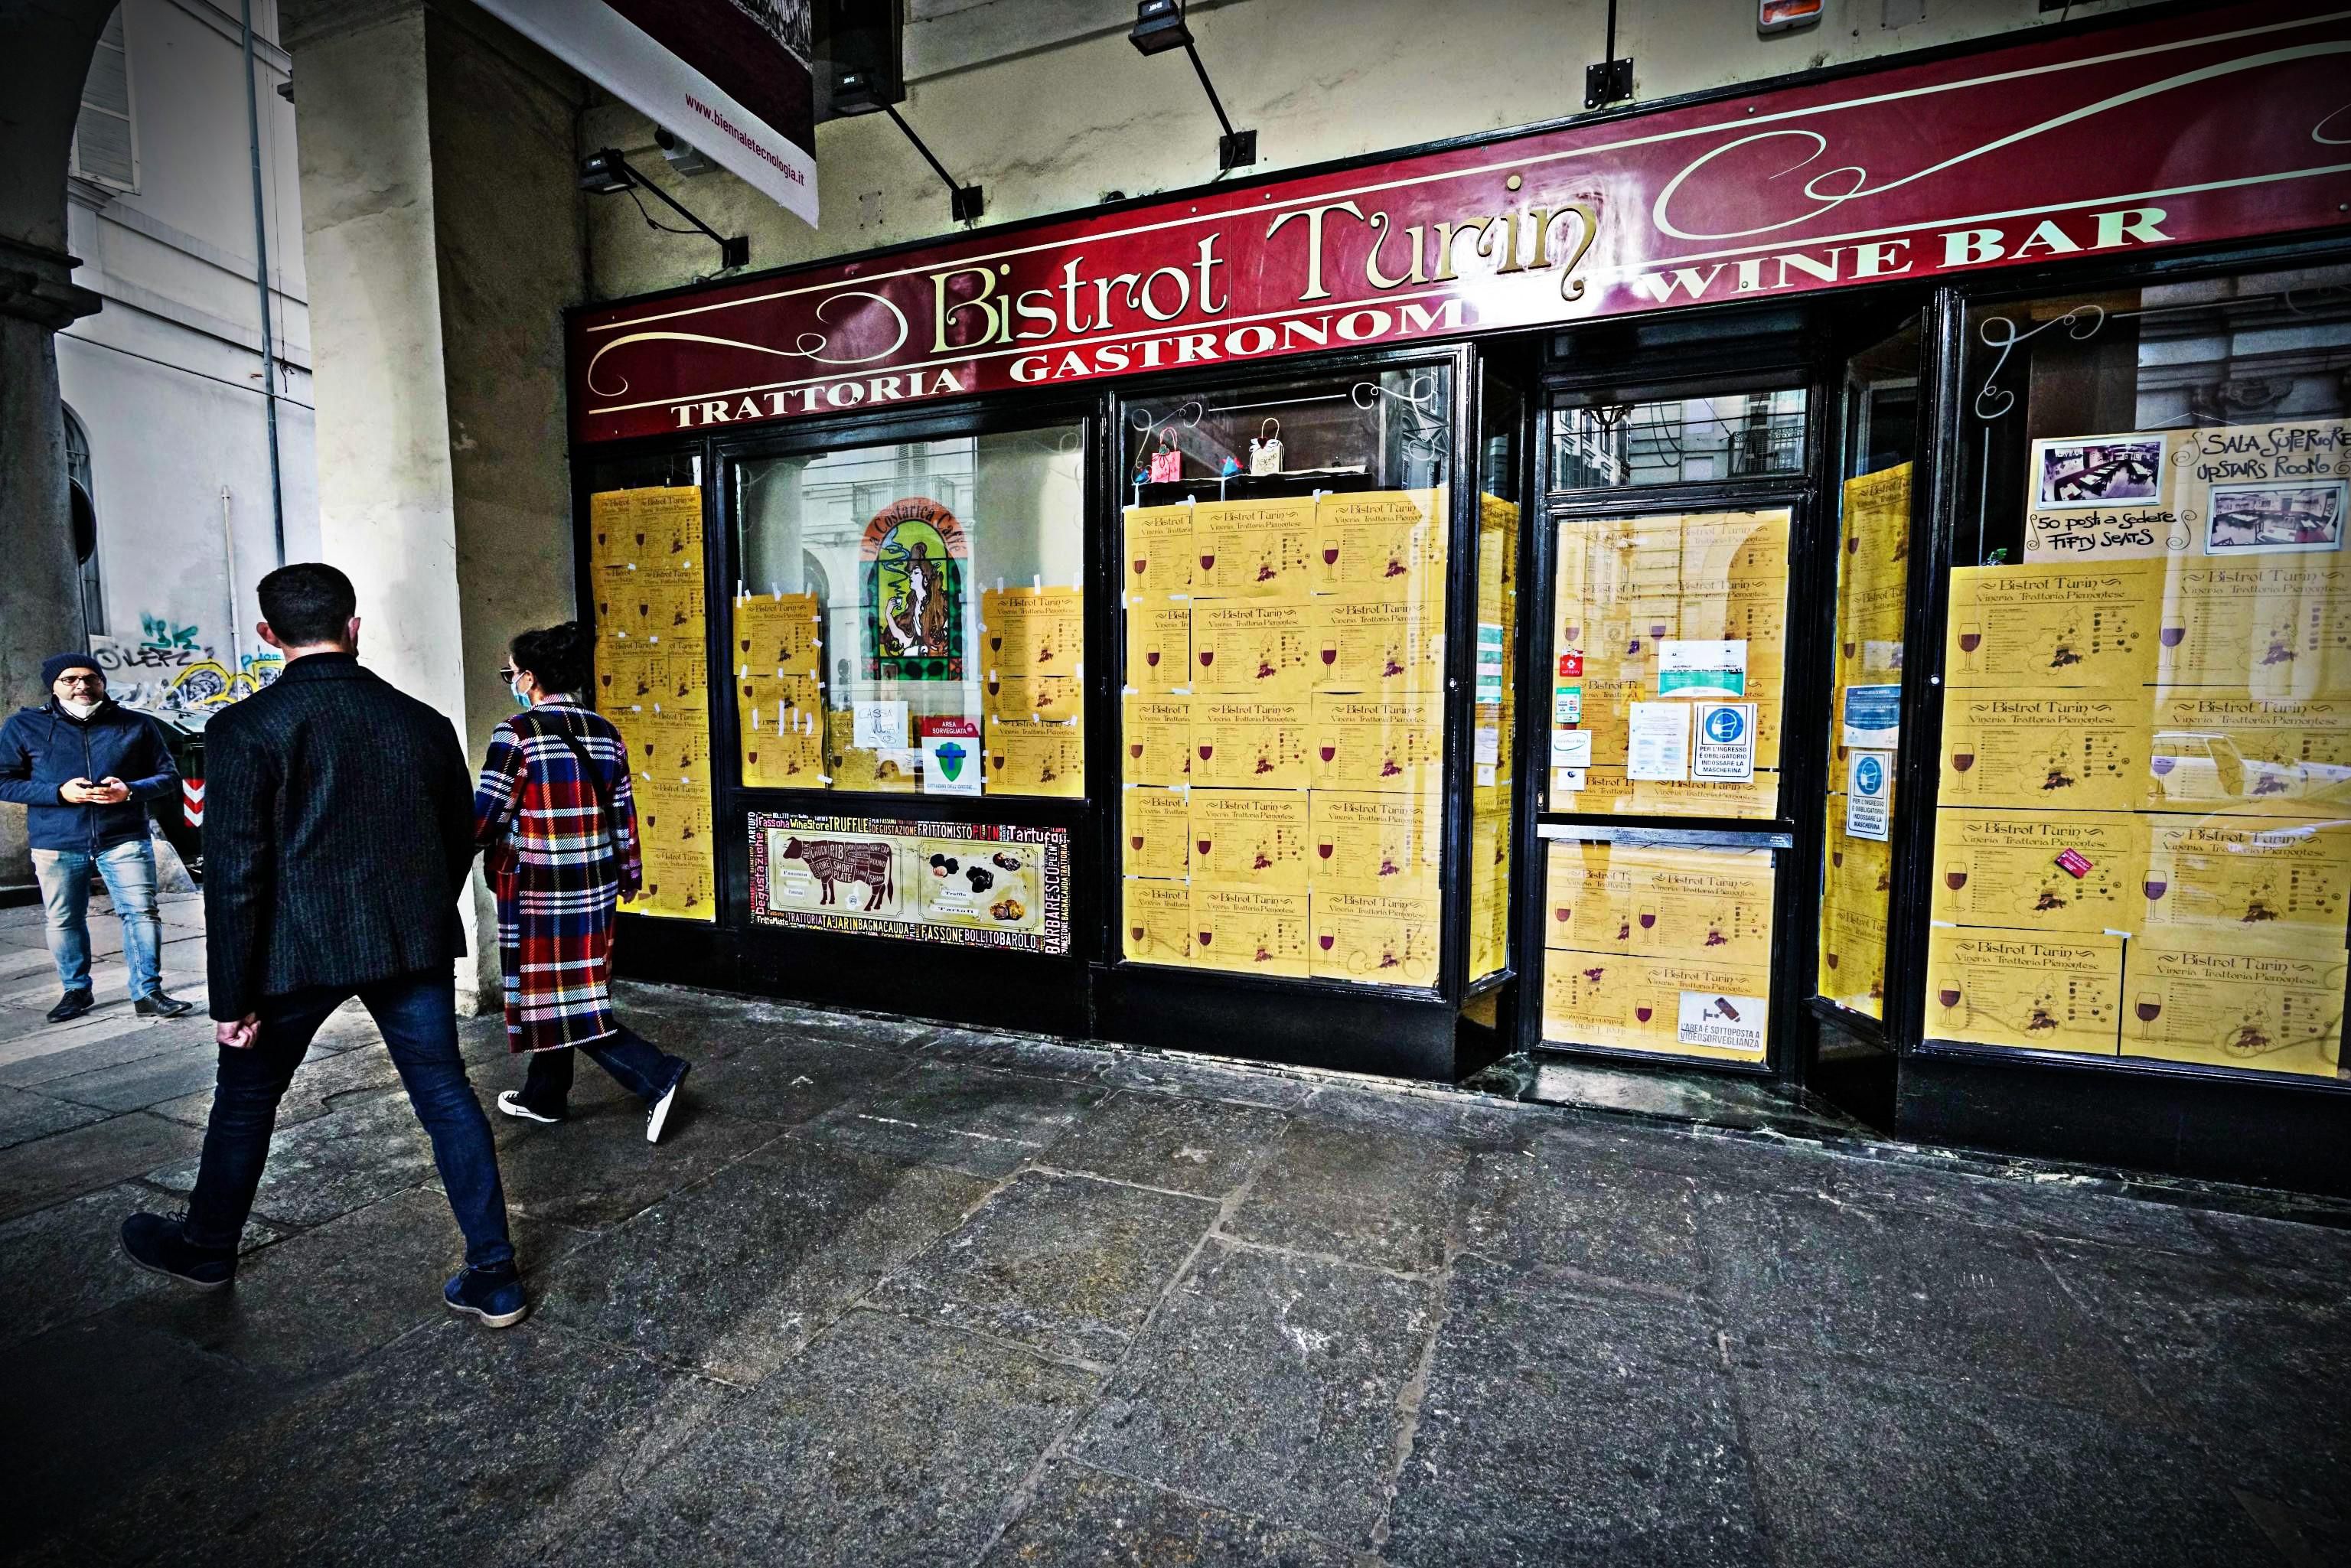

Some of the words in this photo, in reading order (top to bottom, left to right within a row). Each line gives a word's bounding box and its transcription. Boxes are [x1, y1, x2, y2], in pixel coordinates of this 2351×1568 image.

[685, 93, 804, 187] www.biennaletecnologia.it
[929, 232, 1228, 354] Bistrot
[1267, 174, 1598, 302] Turin
[670, 367, 965, 429] TRATTORIA
[1009, 298, 1489, 383] GASTRONOM
[1635, 238, 1913, 302] WINE
[1938, 207, 2175, 269] BAR
[2202, 435, 2260, 455] SALA
[2260, 427, 2351, 457] SUPERIORE
[2196, 459, 2268, 482] UPSTAIRS
[2274, 455, 2330, 478] ROOM
[1224, 513, 1257, 521] Bistrot
[1259, 512, 1286, 522] Turin
[1349, 505, 1384, 513] Bistrot
[1387, 504, 1417, 515] Turin
[875, 504, 934, 534] Costarica
[2037, 517, 2060, 530] 50
[2066, 511, 2102, 531] posti
[2104, 513, 2118, 525] a
[2118, 510, 2177, 530] sedere
[2048, 531, 2095, 552] FIFTY
[2100, 528, 2155, 547] SEATS
[2000, 577, 2051, 591] Bistrot
[2055, 575, 2098, 592] Turin
[2209, 568, 2265, 582] Bistrot
[2270, 567, 2317, 585] Turin
[2017, 590, 2064, 601] Trattoria
[1222, 610, 1254, 618] Bistrot
[1256, 610, 1283, 619] Turin
[1346, 605, 1381, 614] Bistrot
[1383, 605, 1411, 615] Turin
[1255, 706, 1281, 716] Turin
[1346, 706, 1381, 714] Bistrot
[1383, 706, 1411, 716] Turin
[1993, 701, 2043, 713] Bistrot
[2047, 700, 2089, 716] Turin
[2199, 699, 2255, 713] Bistrot
[2260, 699, 2307, 717] Turin
[2010, 714, 2056, 724] Trattoria
[2220, 714, 2271, 725] Trattoria
[1253, 803, 1279, 812] Turin
[1343, 805, 1378, 813] Bistrot
[1380, 806, 1408, 817] Turin
[748, 812, 756, 843] TARTUFO
[790, 819, 830, 831] WineStore
[829, 817, 869, 833] TRUFFLE
[872, 824, 918, 836] DEGUSTAZIONE
[918, 824, 972, 839] FRITTOMISTO
[1984, 821, 2035, 835] Bistrot
[2040, 823, 2082, 838] Turin
[2002, 835, 2048, 846] Trattoria
[2189, 826, 2245, 842] Bistrot
[811, 845, 828, 858] CHUCK
[830, 844, 844, 859] RIB
[816, 860, 830, 871] FORE
[833, 861, 853, 872] SHORT
[755, 832, 768, 915] Degustazione
[833, 872, 853, 882] PLATE
[1668, 874, 1705, 885] Bistrot
[1708, 876, 1740, 888] Turin
[1253, 895, 1279, 905] Turin
[1343, 897, 1378, 906] Bistrot
[1380, 898, 1408, 909] Turin
[1045, 867, 1061, 954] BARBARESCO
[788, 912, 822, 925] TRATTORIA
[822, 915, 859, 931] TAJARIN
[859, 919, 909, 935] BAGNACAUDA
[921, 925, 964, 943] FASSONE
[964, 928, 999, 944] BOLLITO
[1000, 932, 1036, 949] BAROLO
[1978, 941, 2027, 955] Bistrot
[2032, 944, 2073, 960] Turin
[1995, 955, 2040, 967] Trattoria
[2182, 953, 2238, 969] Bistrot
[2242, 955, 2289, 973] Turin
[1664, 970, 1701, 980] Bistrot
[1704, 972, 1734, 984] Turin
[2200, 967, 2252, 980] Trattoria
[1681, 1023, 1703, 1032] L'AREA
[1711, 1025, 1754, 1038] SOTTOPOSTA
[1755, 1031, 1760, 1039] A
[1680, 1031, 1759, 1048] VIDEOSORVEGLIANZA
